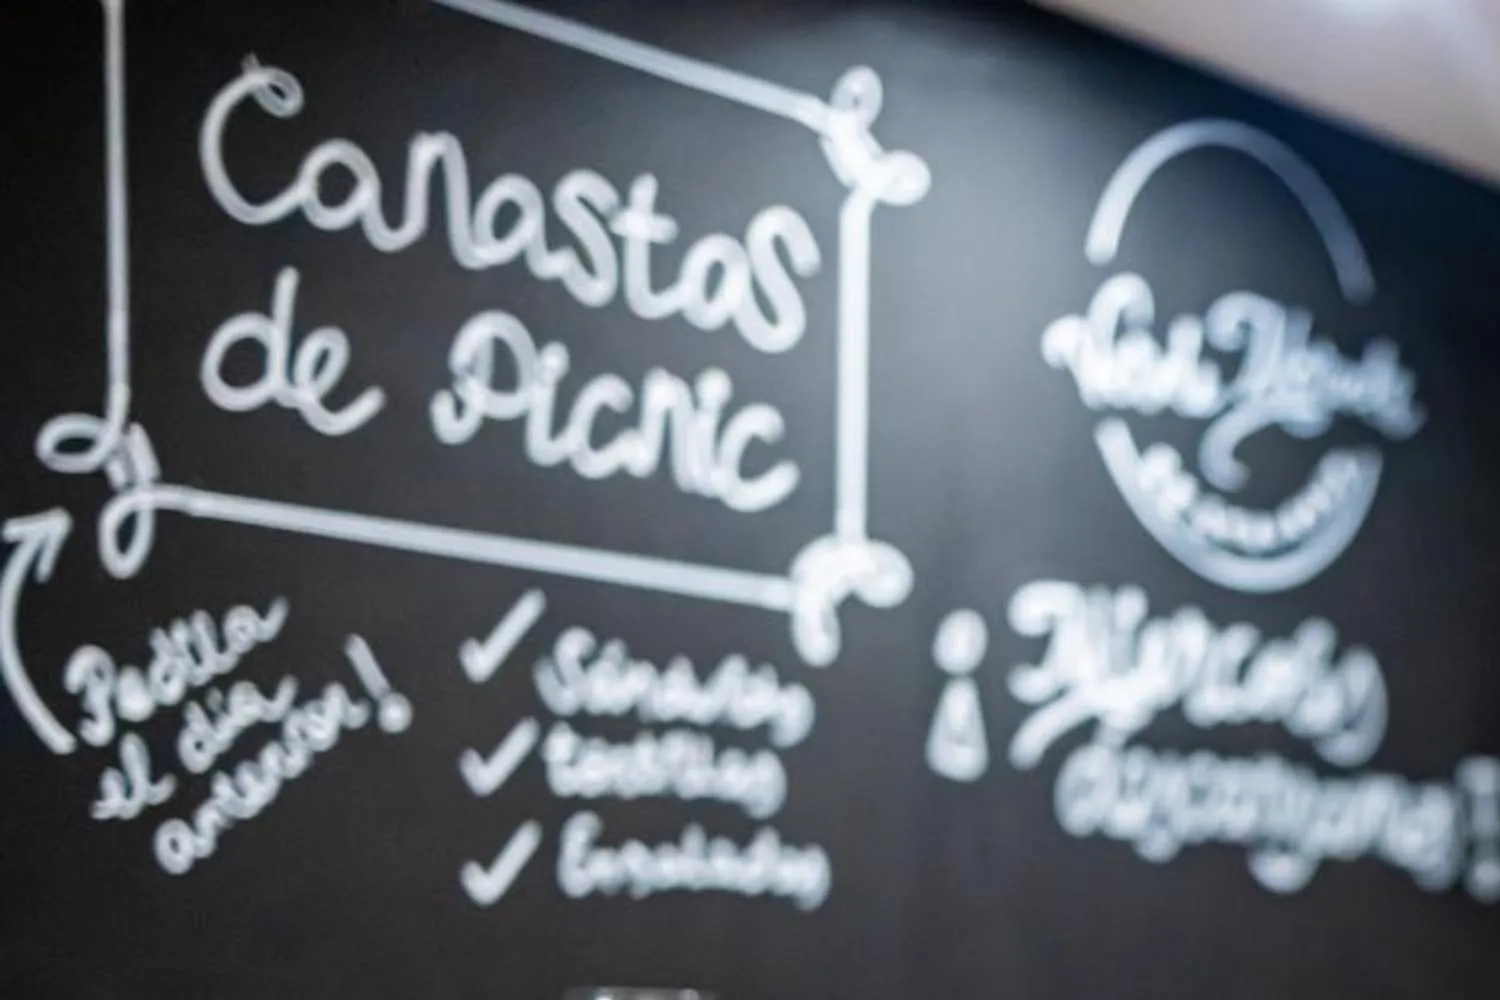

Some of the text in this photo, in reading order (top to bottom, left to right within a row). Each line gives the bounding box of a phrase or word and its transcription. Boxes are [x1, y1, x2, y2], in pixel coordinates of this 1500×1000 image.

[200, 53, 821, 352] Canastas
[201, 267, 801, 511] de Picnic
